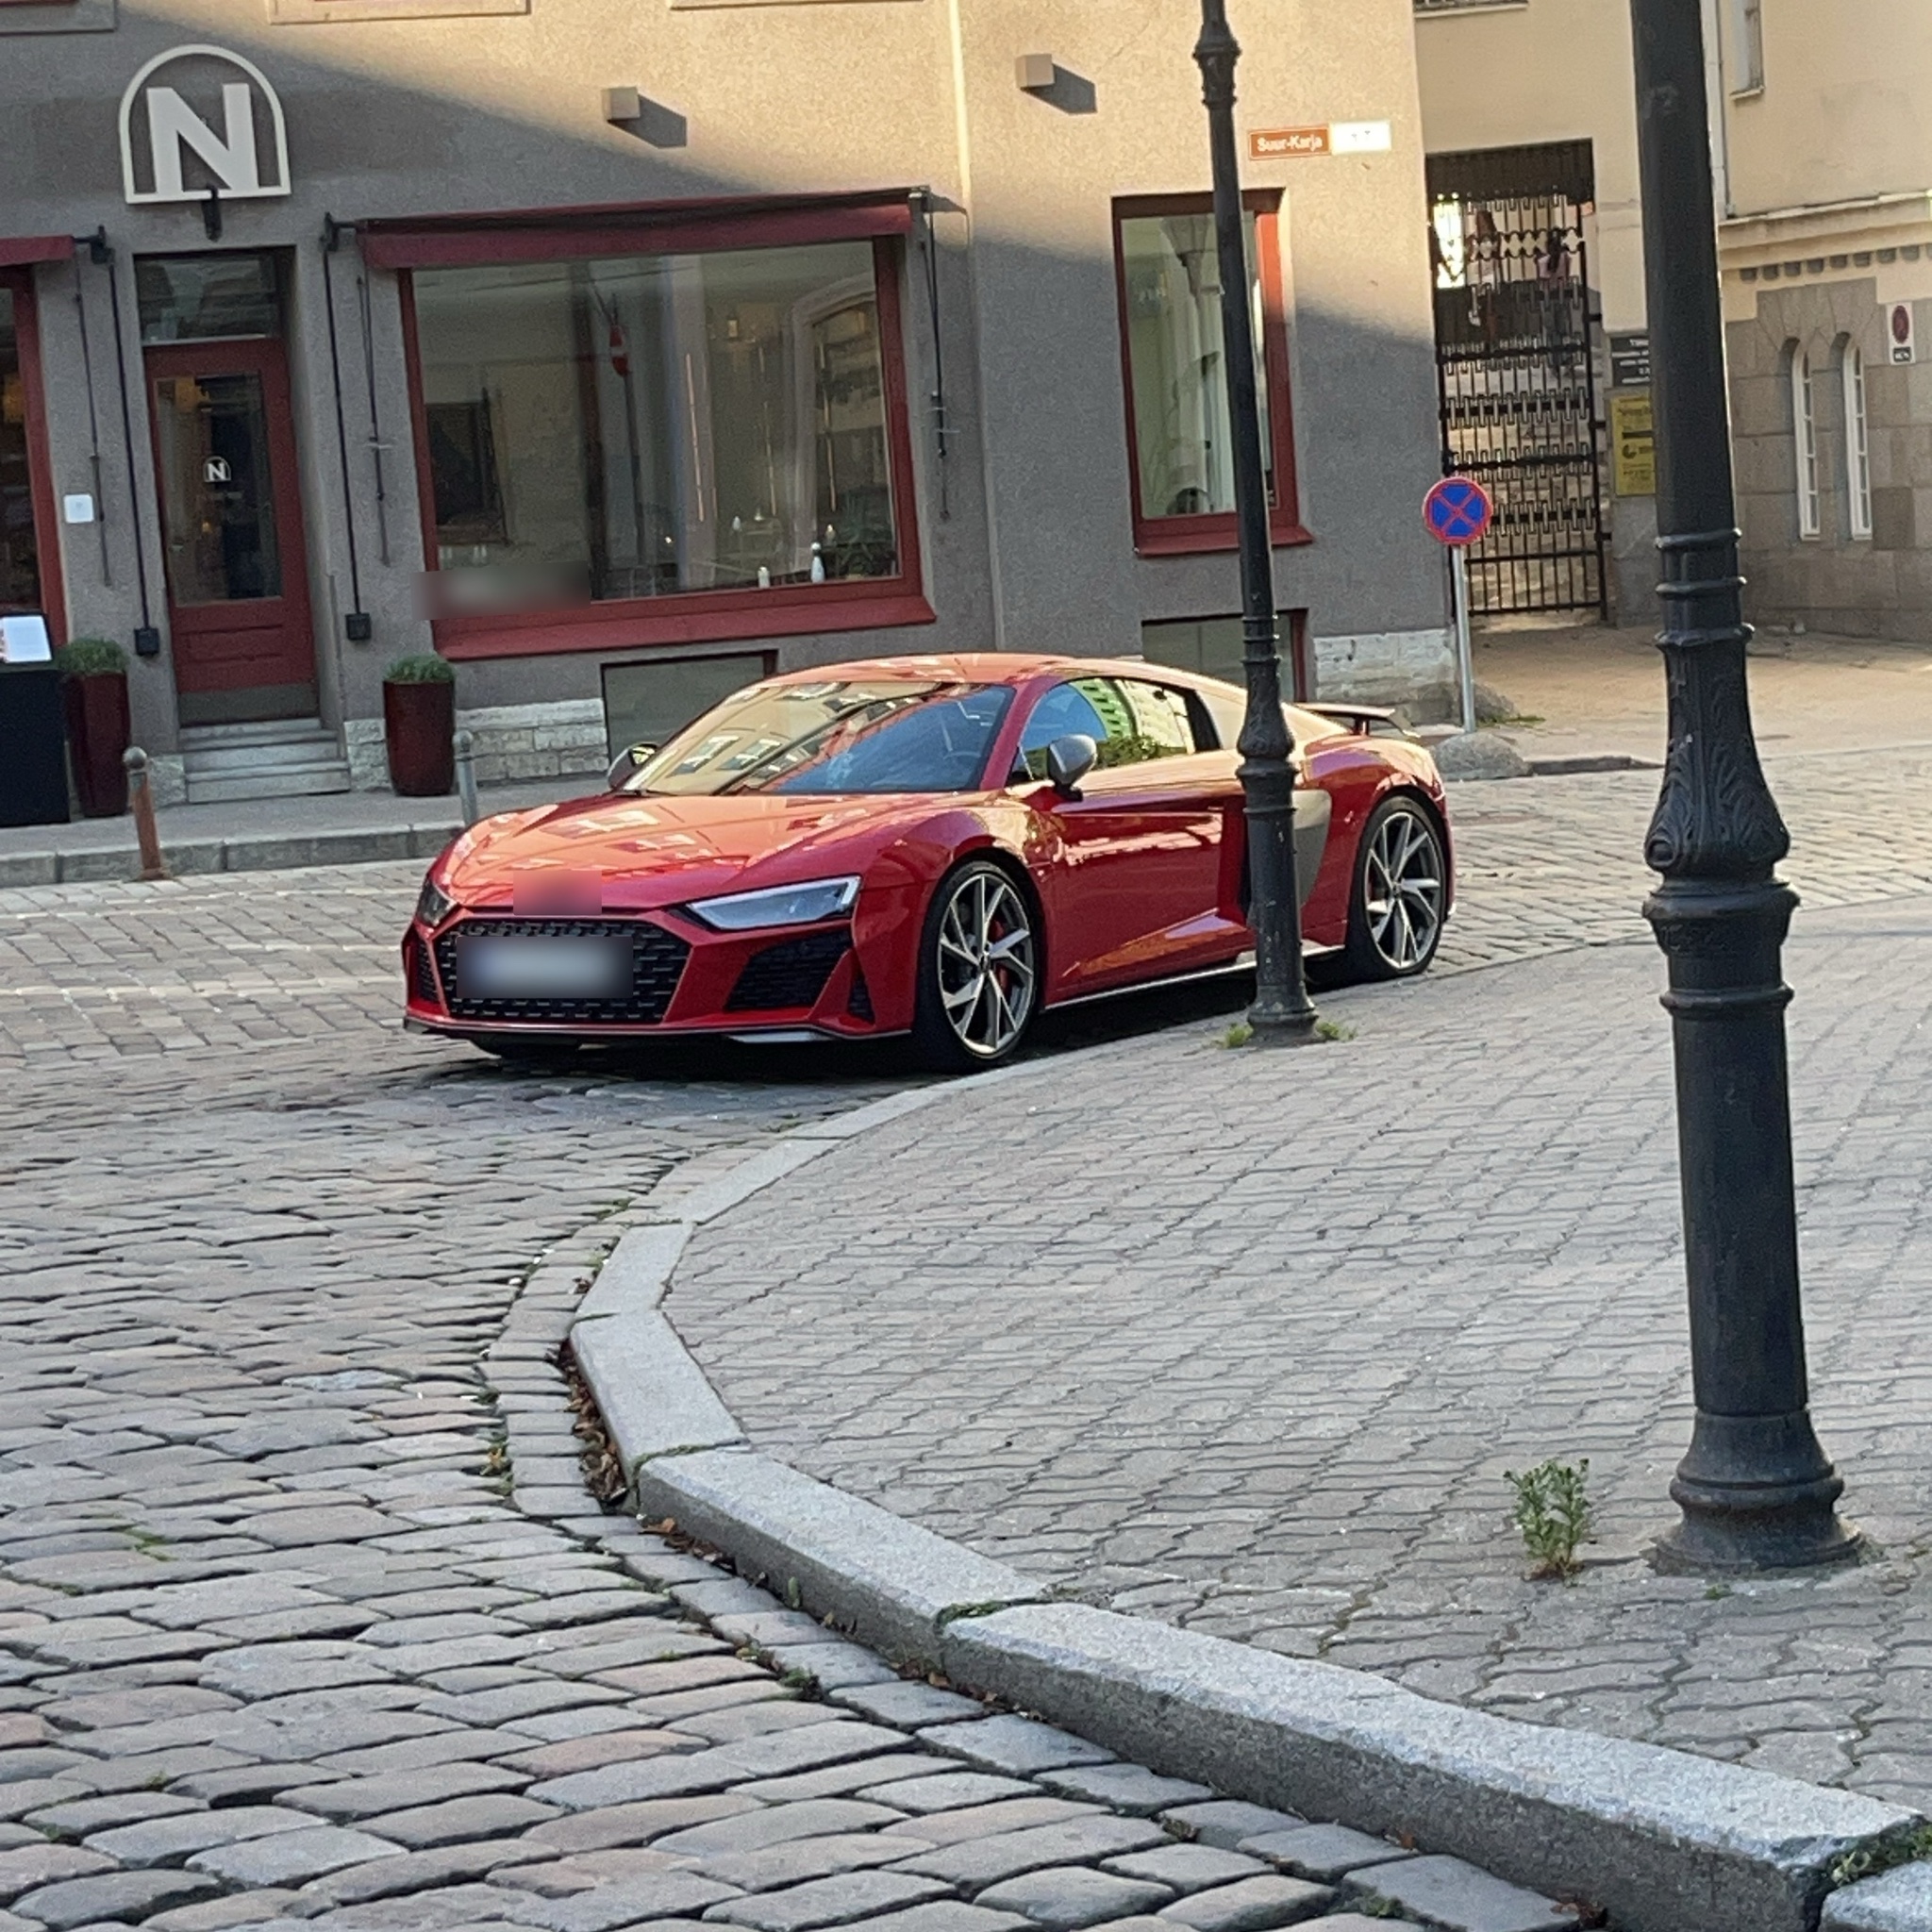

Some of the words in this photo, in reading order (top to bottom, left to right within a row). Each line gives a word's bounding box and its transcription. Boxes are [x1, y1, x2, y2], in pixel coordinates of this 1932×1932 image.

[146, 82, 259, 196] N
[1257, 134, 1323, 152] Suur-Karja
[208, 462, 226, 481] N
